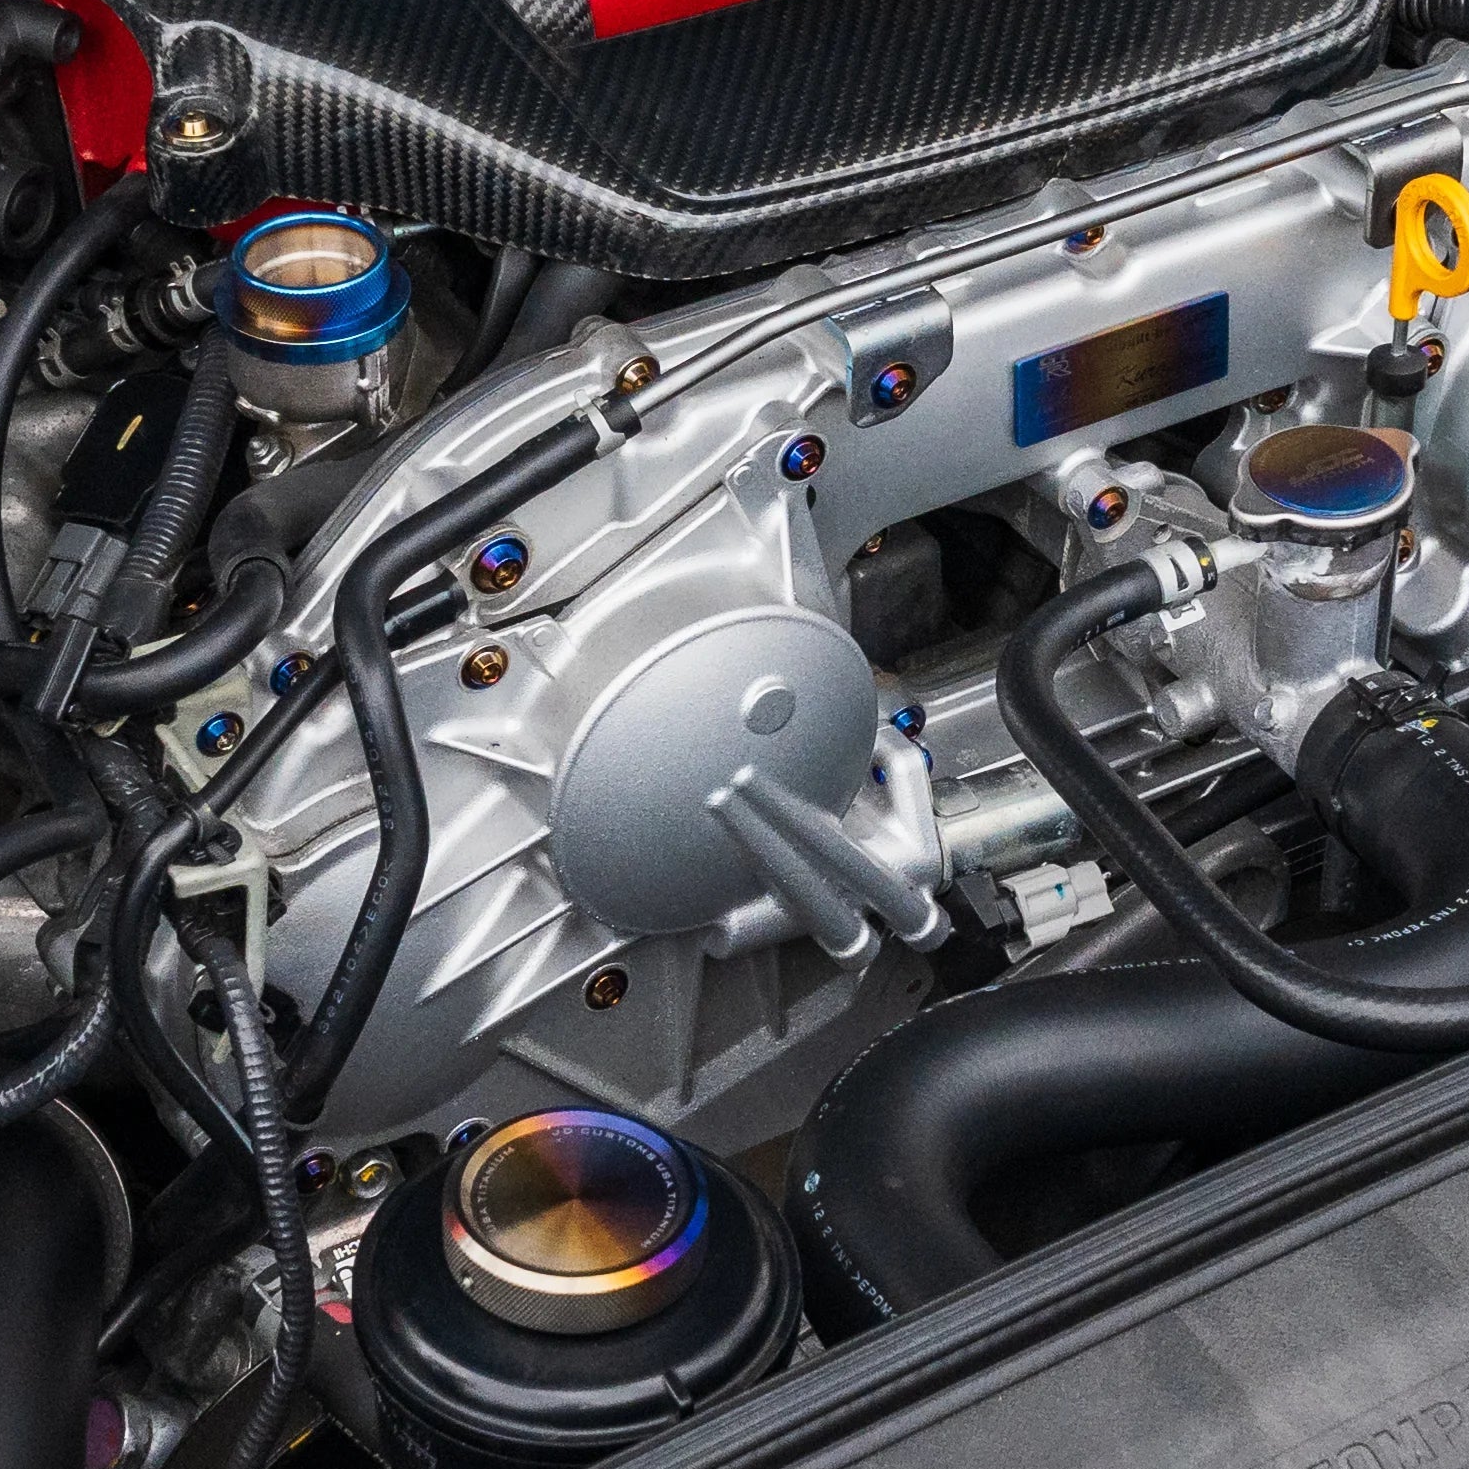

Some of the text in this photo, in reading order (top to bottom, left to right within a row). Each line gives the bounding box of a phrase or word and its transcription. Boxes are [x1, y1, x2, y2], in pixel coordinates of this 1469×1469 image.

[579, 1127, 656, 1162] CUSTOMS
[477, 1144, 516, 1204] TITANIUM
[654, 1162, 674, 1189] USA
[641, 1191, 677, 1249] TITANIUM
